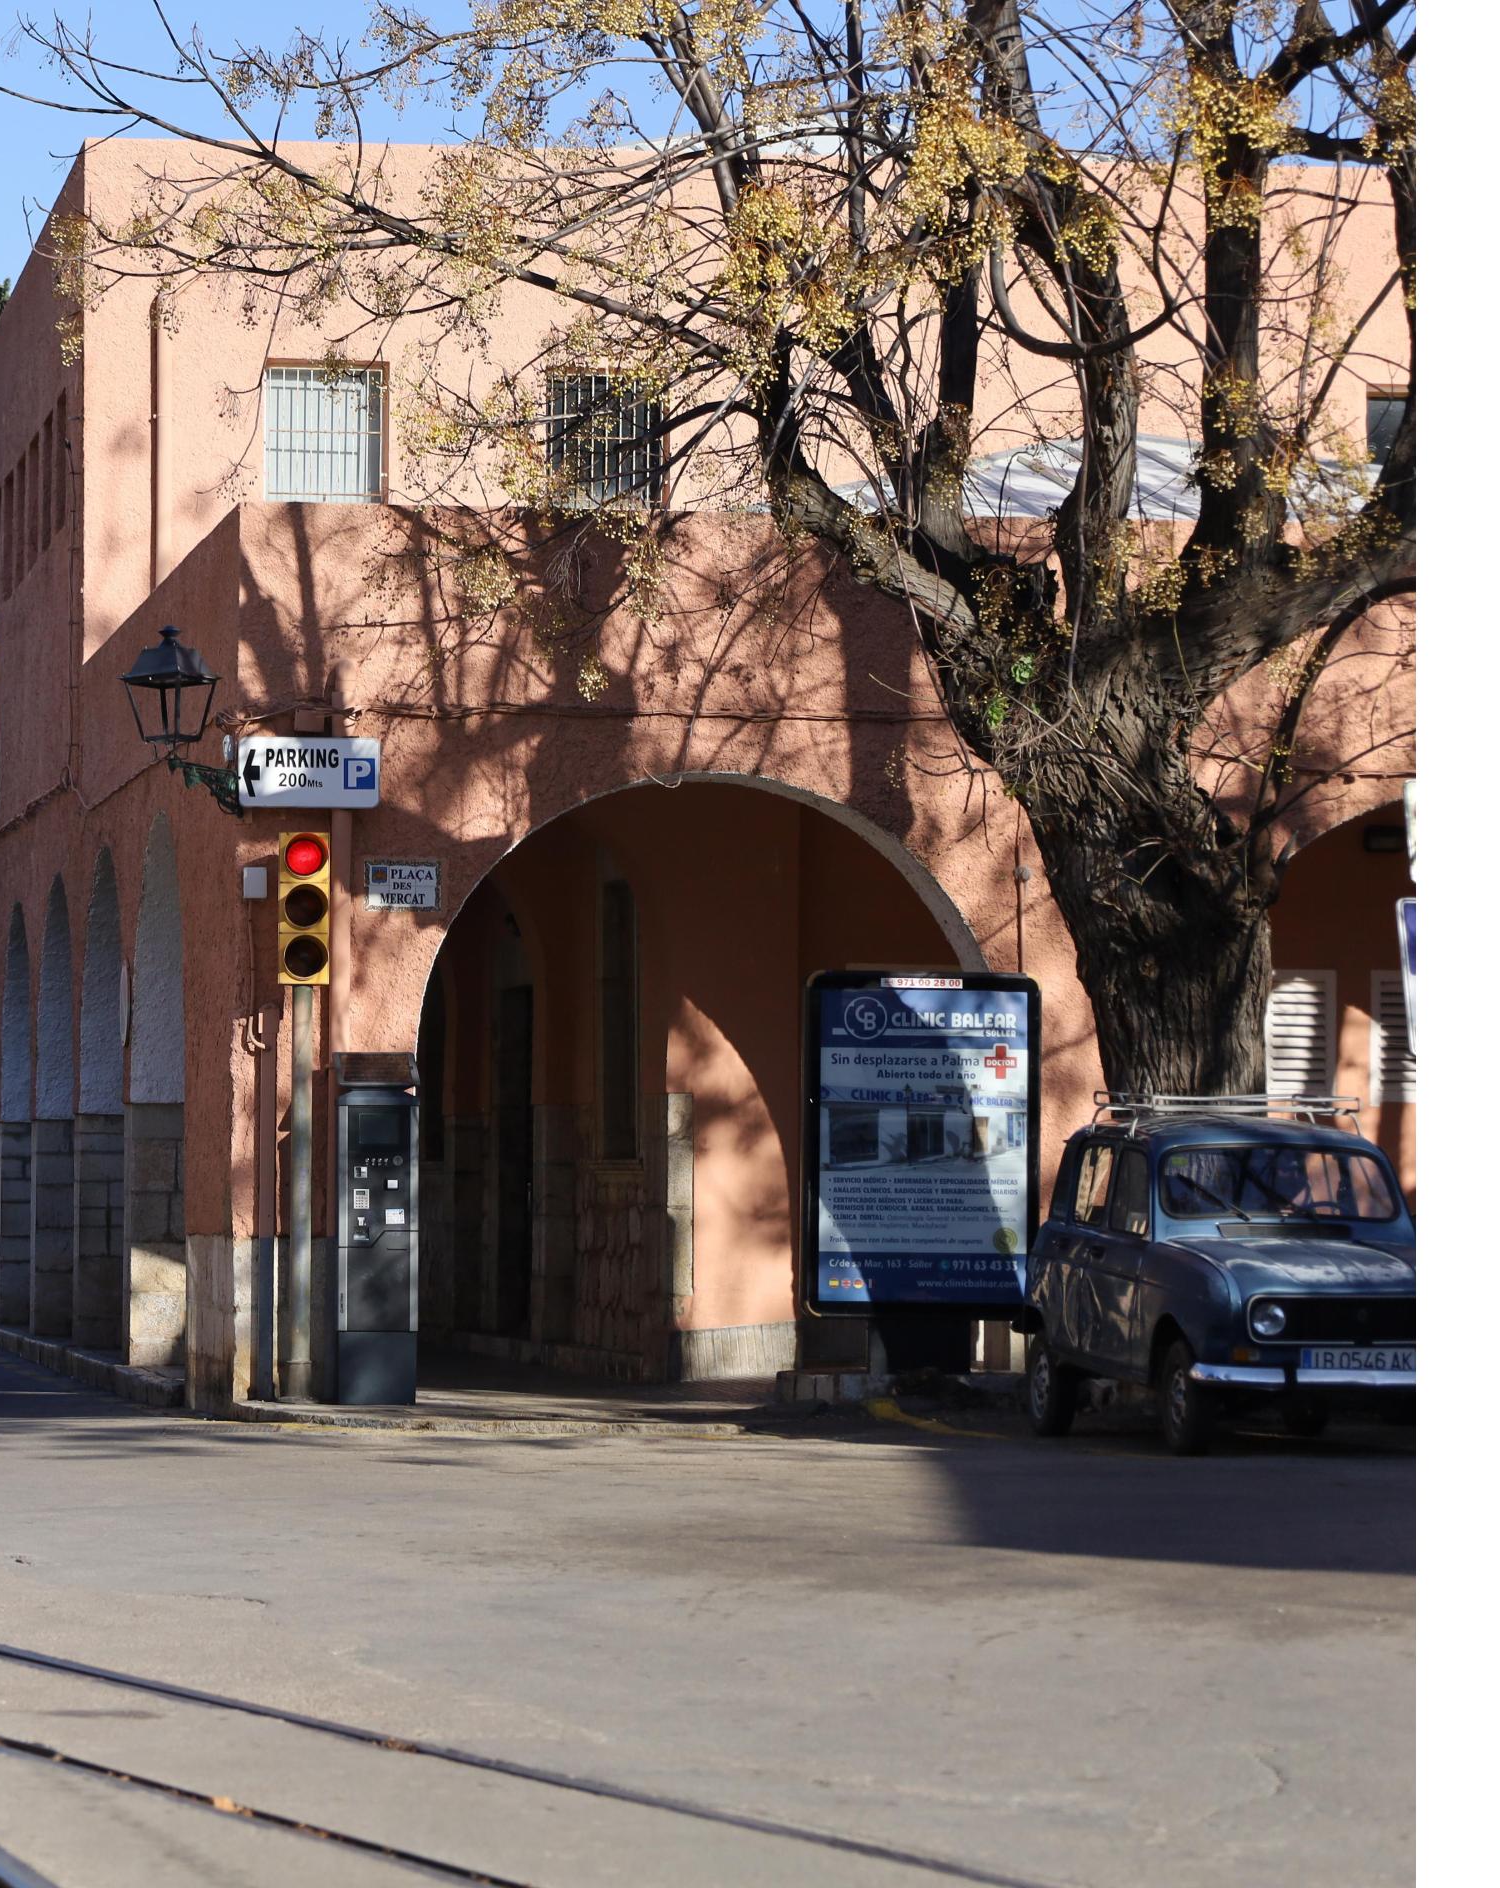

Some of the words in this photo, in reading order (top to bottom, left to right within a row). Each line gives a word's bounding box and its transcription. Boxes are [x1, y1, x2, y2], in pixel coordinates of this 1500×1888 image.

[265, 748, 340, 768] PARKING
[347, 760, 371, 788] P
[390, 868, 434, 882] PLAÇA
[392, 881, 412, 890] DES
[379, 892, 426, 905] MERCAT
[933, 979, 946, 987] 28
[949, 979, 961, 987] 00
[891, 1012, 945, 1028] CLINIC
[951, 1012, 1017, 1029] BALEAR
[831, 1053, 850, 1065] Sin
[853, 1054, 927, 1067] desplazarse
[930, 1057, 938, 1066] a
[941, 1055, 980, 1066] Palma
[876, 1069, 915, 1079] Abierto
[918, 1070, 942, 1079] todo
[945, 1070, 955, 1079] el
[957, 1070, 976, 1080] año
[851, 1089, 891, 1101] CLINIC
[833, 1176, 861, 1184] SERVICIO
[829, 1258, 850, 1268] C/de
[887, 1260, 901, 1268] 163
[952, 1260, 970, 1270] 971
[974, 1260, 986, 1271] 63
[989, 1260, 1002, 1271] 43
[1339, 1351, 1386, 1369] 0546
[1391, 1351, 1413, 1370] AK
